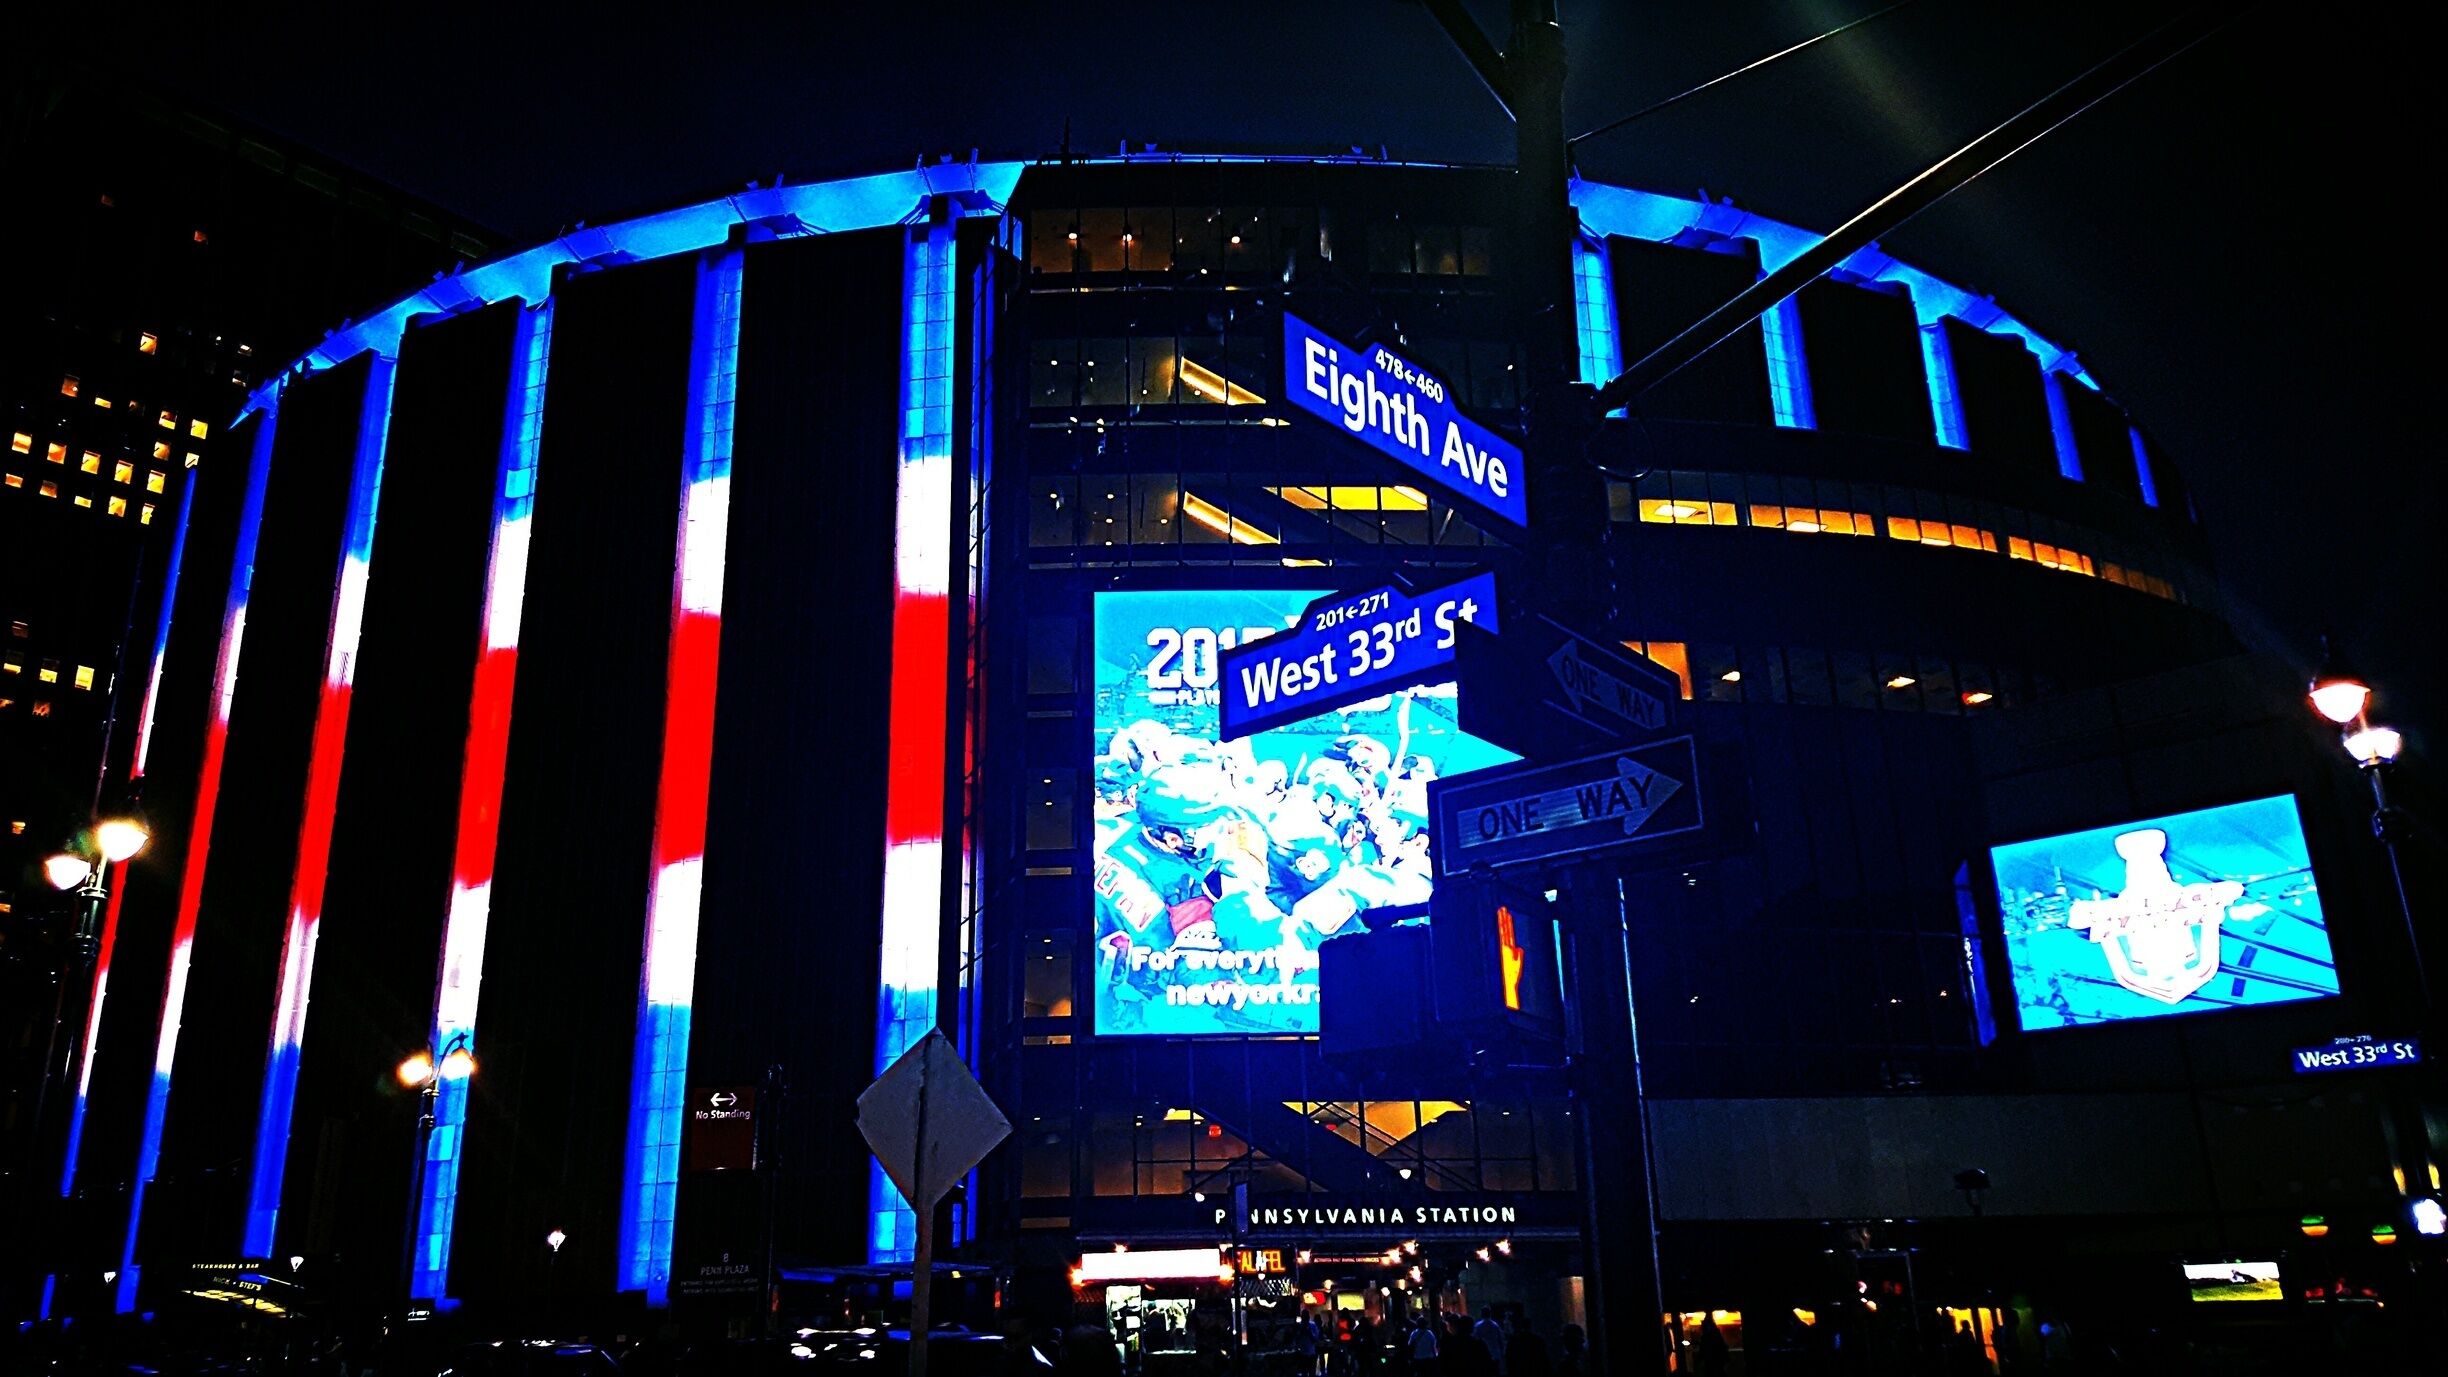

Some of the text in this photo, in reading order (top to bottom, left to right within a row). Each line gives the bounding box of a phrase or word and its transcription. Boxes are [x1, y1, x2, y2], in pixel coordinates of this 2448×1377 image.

[1375, 348, 1444, 404] 478 460
[1305, 337, 1508, 497] Eighth Ave
[1315, 592, 1389, 632] 201 271
[1241, 597, 1478, 708] West 33rd St
[1561, 654, 1656, 725] ONE WAY
[1478, 773, 1654, 840] ONE WAY
[1166, 983, 1320, 1011] newyorkr
[2298, 1043, 2415, 1068] West 33rd St
[695, 1109, 751, 1121] No Standing
[1215, 1207, 1516, 1224] PNNSYLVANIA STATION
